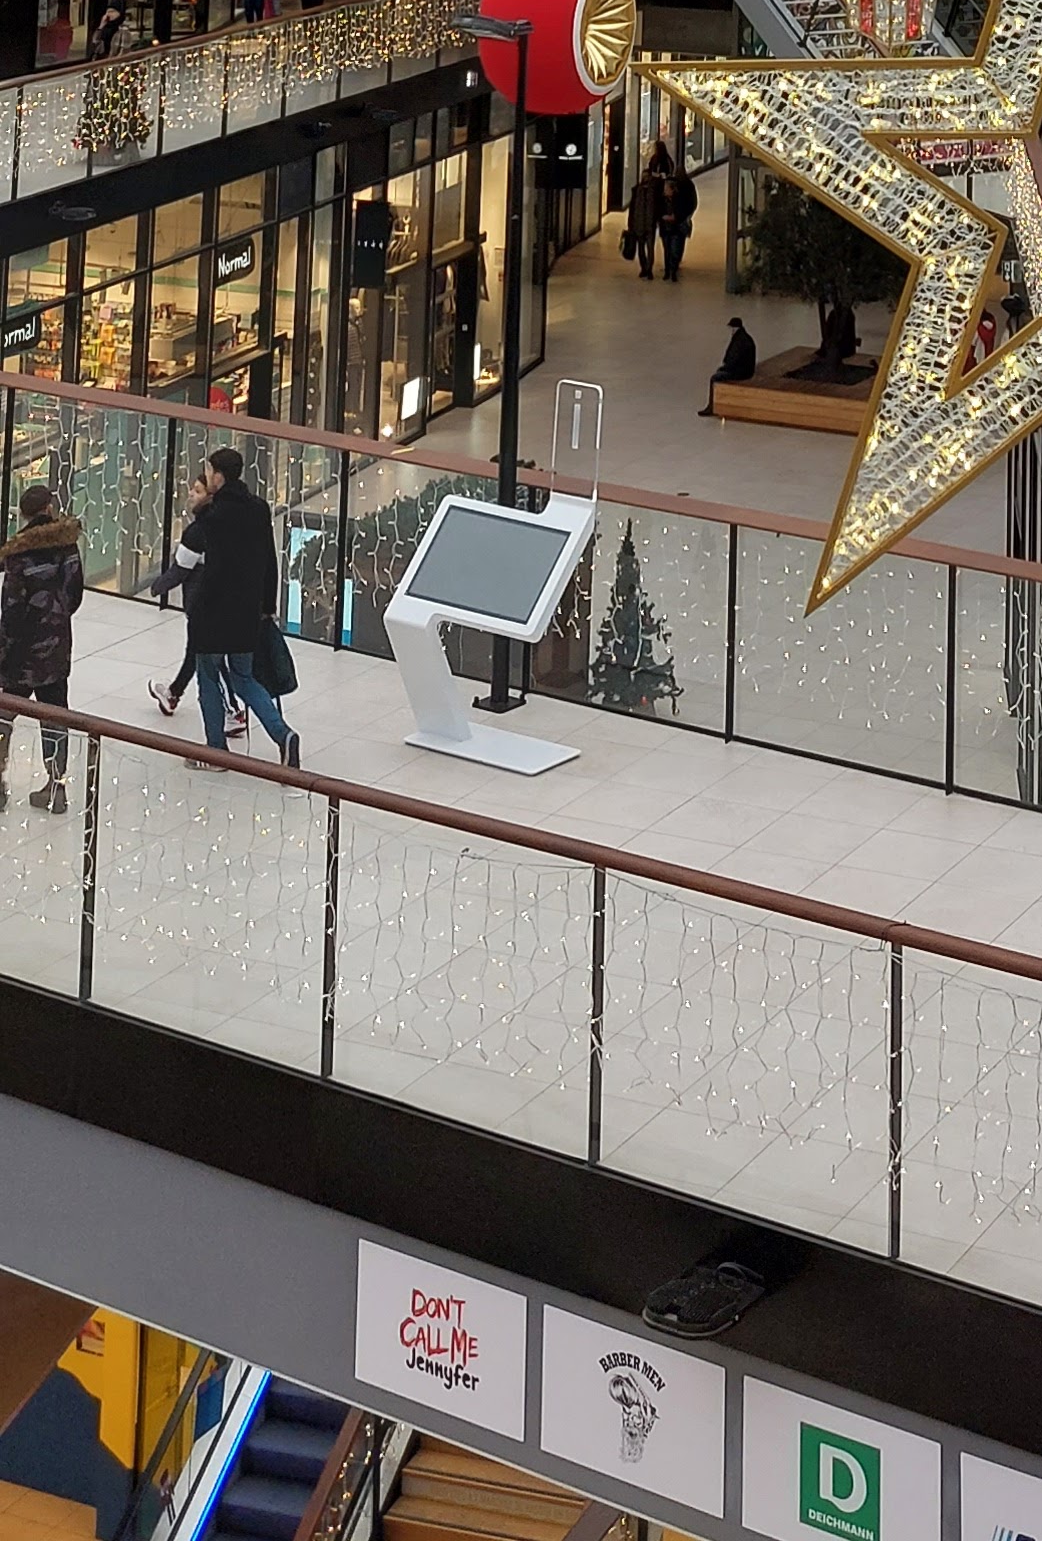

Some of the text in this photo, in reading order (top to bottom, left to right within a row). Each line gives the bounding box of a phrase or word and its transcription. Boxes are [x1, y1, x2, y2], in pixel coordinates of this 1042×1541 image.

[218, 245, 251, 279] Normal
[411, 1287, 466, 1330] DON'T
[399, 1316, 480, 1368] CALL ME
[405, 1347, 480, 1392] Jennyfer
[598, 1351, 667, 1393] BARBER MEN
[819, 1442, 868, 1513] D
[807, 1508, 875, 1541] DEICHMANN
